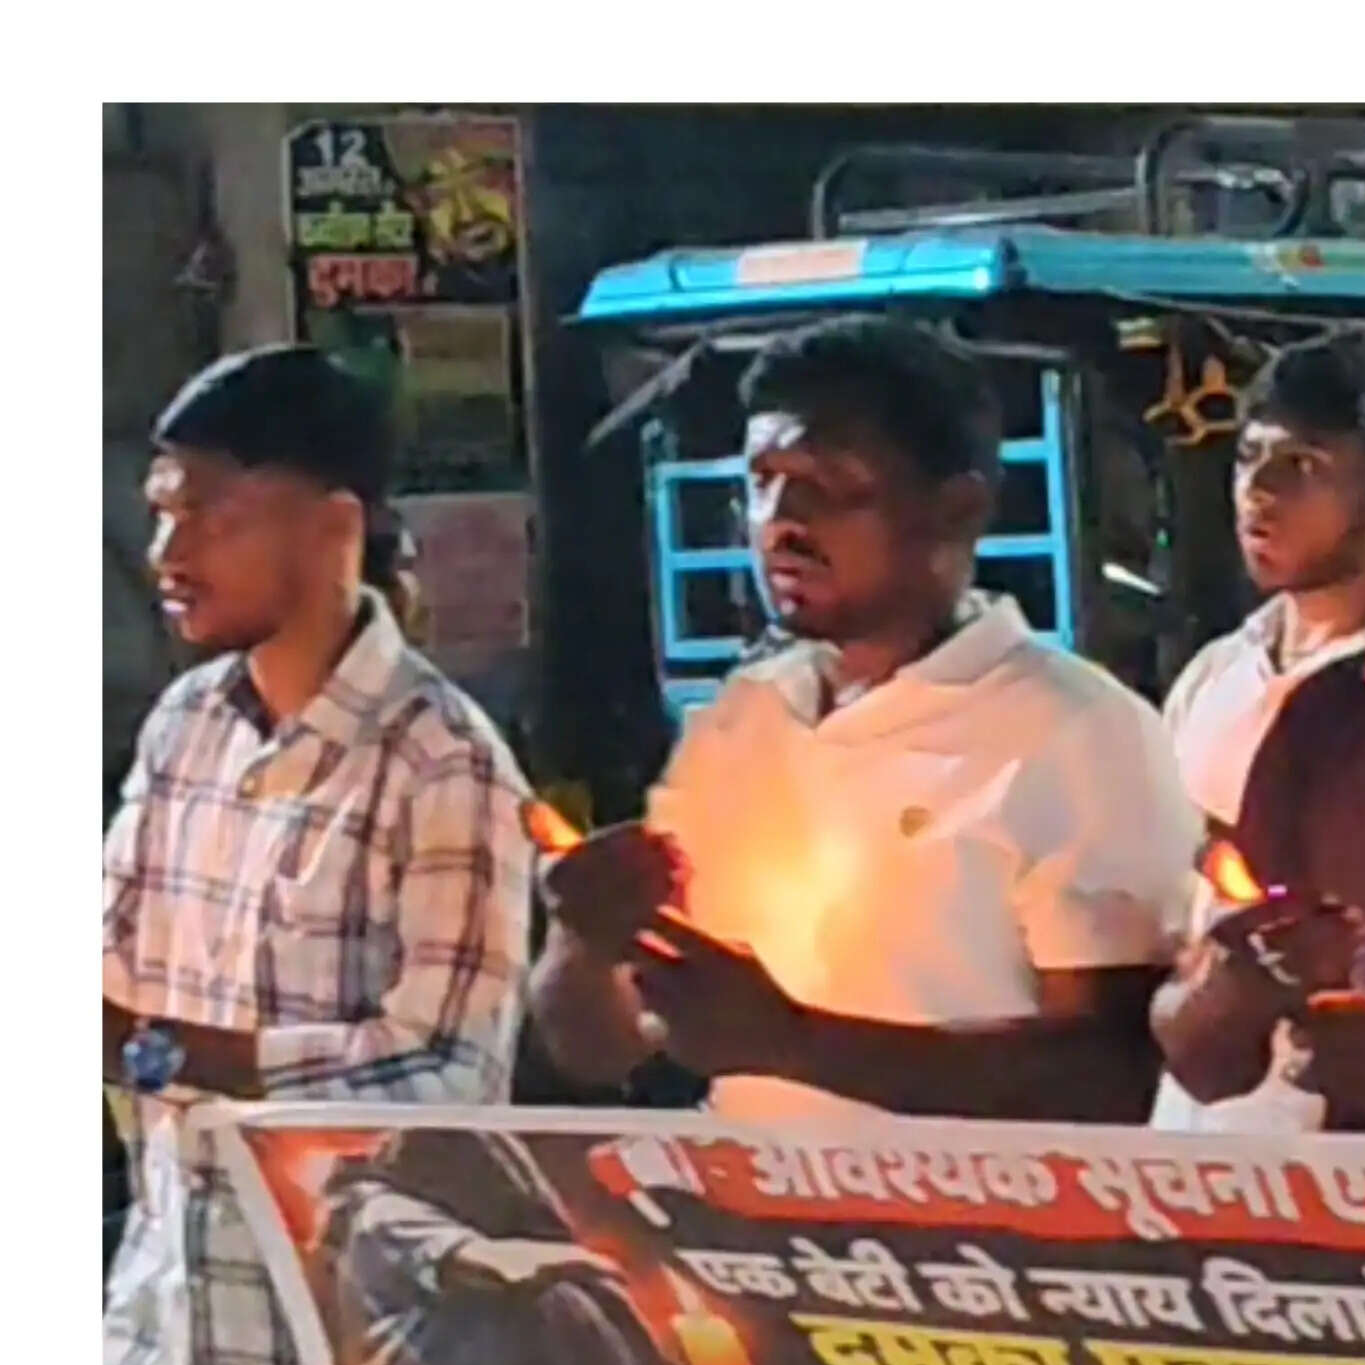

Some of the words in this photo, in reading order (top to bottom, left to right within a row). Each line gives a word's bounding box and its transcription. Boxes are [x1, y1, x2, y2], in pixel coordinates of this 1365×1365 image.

[1077, 1154, 1300, 1241] सूचना
[675, 1250, 798, 1299] एक
[788, 1236, 922, 1312] बेटी
[914, 1244, 1040, 1321] को
[1026, 1268, 1203, 1333] न्याय
